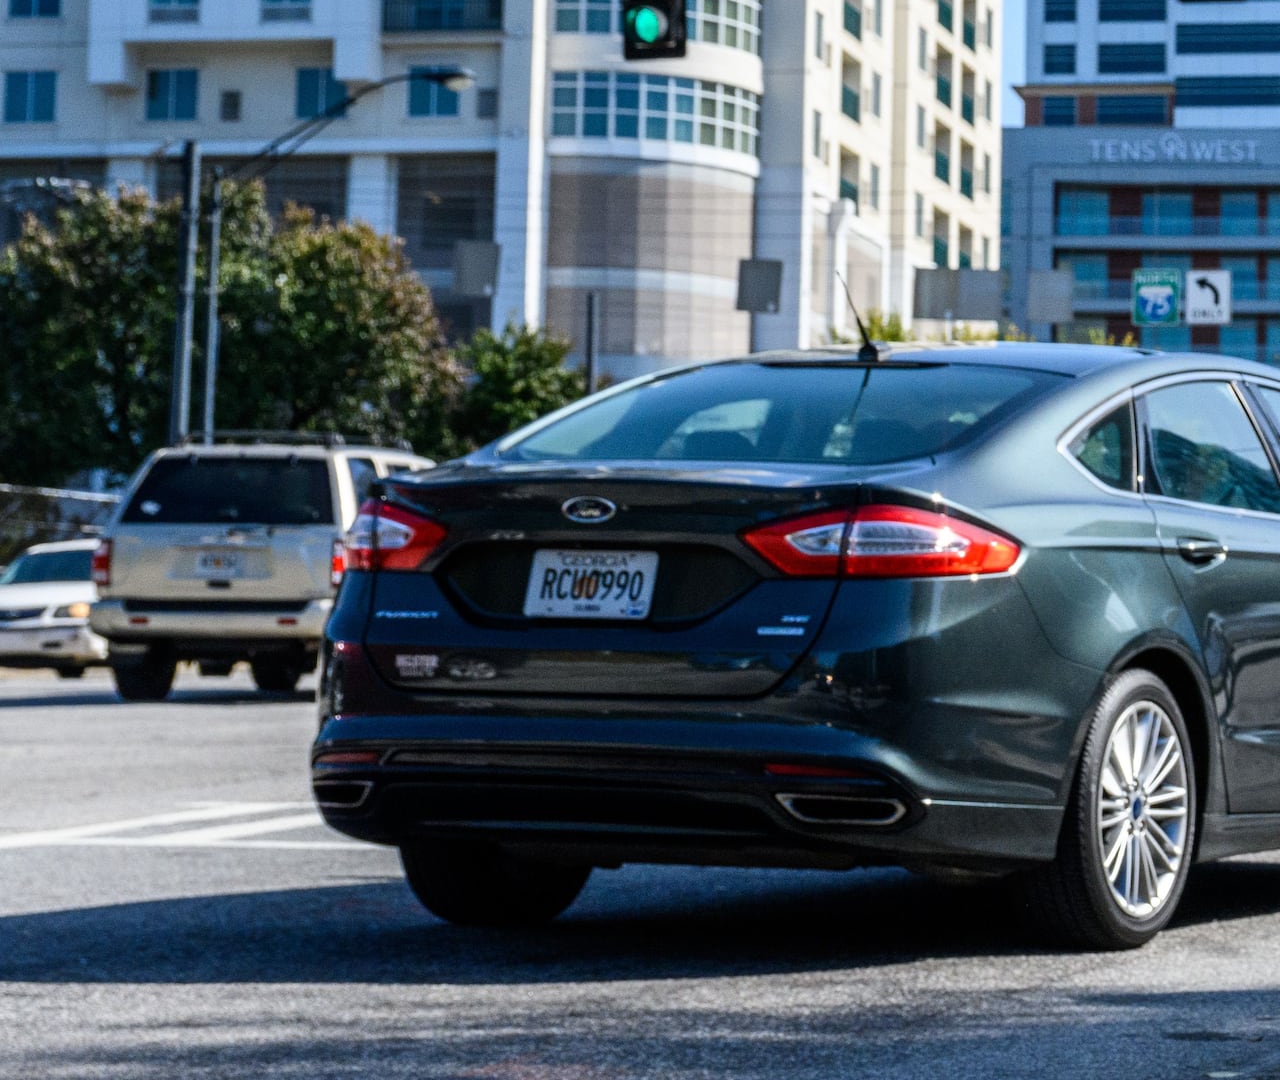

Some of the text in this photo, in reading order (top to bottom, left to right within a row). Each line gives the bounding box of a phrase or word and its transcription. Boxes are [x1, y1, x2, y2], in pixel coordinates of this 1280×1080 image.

[1087, 139, 1157, 163] TENS
[1191, 139, 1260, 163] WEST
[1144, 297, 1171, 316] 75
